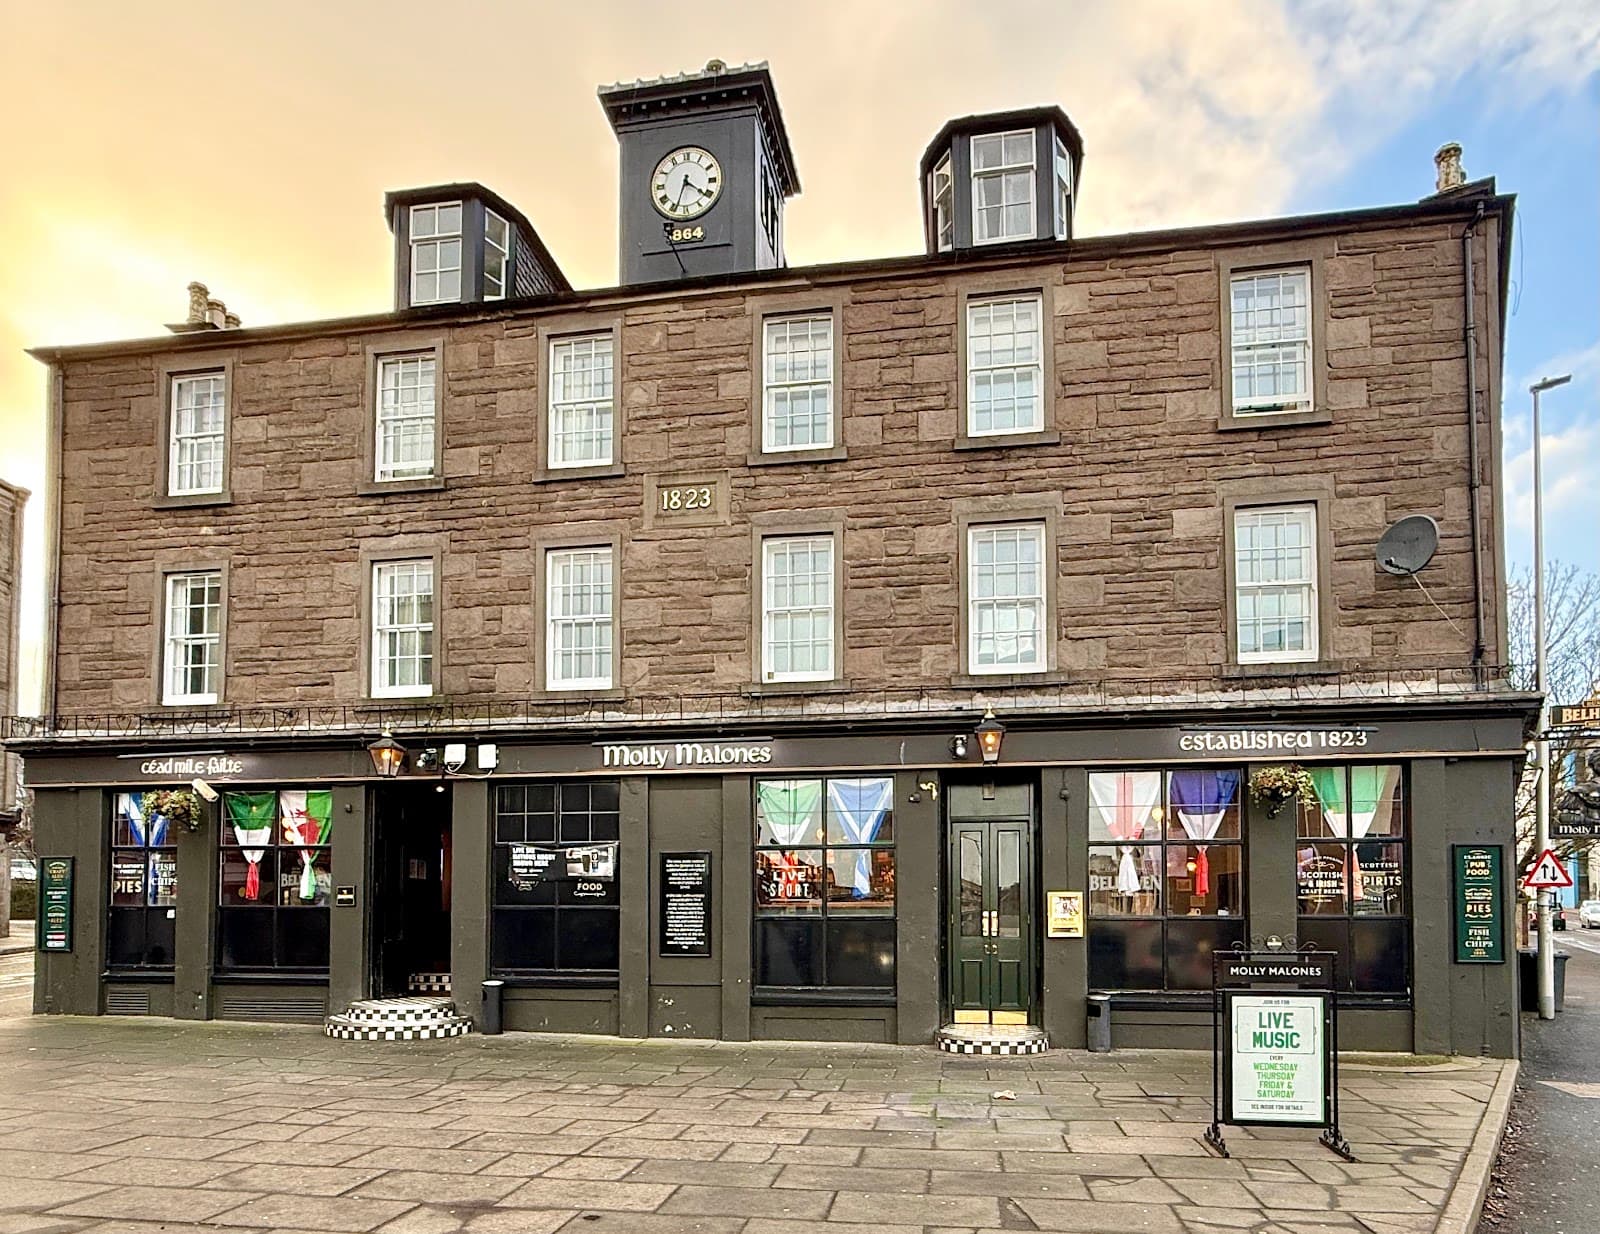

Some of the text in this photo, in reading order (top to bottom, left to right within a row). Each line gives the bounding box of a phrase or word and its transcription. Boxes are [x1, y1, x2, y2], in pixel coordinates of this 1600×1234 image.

[662, 488, 711, 510] 1823
[1318, 732, 1368, 748] 1823
[603, 743, 772, 768] Molly Malones
[1559, 825, 1591, 836] Molly
[155, 863, 176, 871] FISH
[773, 871, 806, 881] LIVE
[1301, 871, 1343, 879] SCOTTISH
[1466, 868, 1490, 876] FOOD
[151, 877, 178, 886] CHIPS
[1355, 876, 1402, 886] SPIRITS
[113, 880, 142, 893] PIES
[577, 883, 603, 891] FOOD
[769, 883, 810, 897] SPORT
[1466, 904, 1491, 913] PIES
[1468, 928, 1490, 936] FISH
[1230, 966, 1322, 976] MOLLY MALONES
[1258, 1011, 1294, 1029] LIVE
[1252, 1031, 1300, 1049] MUSIC
[1253, 1062, 1299, 1071] WEDNESDAY
[1256, 1071, 1295, 1080] THURSDAY
[1259, 1080, 1285, 1089] FRIDAY
[1256, 1090, 1295, 1098] SATURDAY
